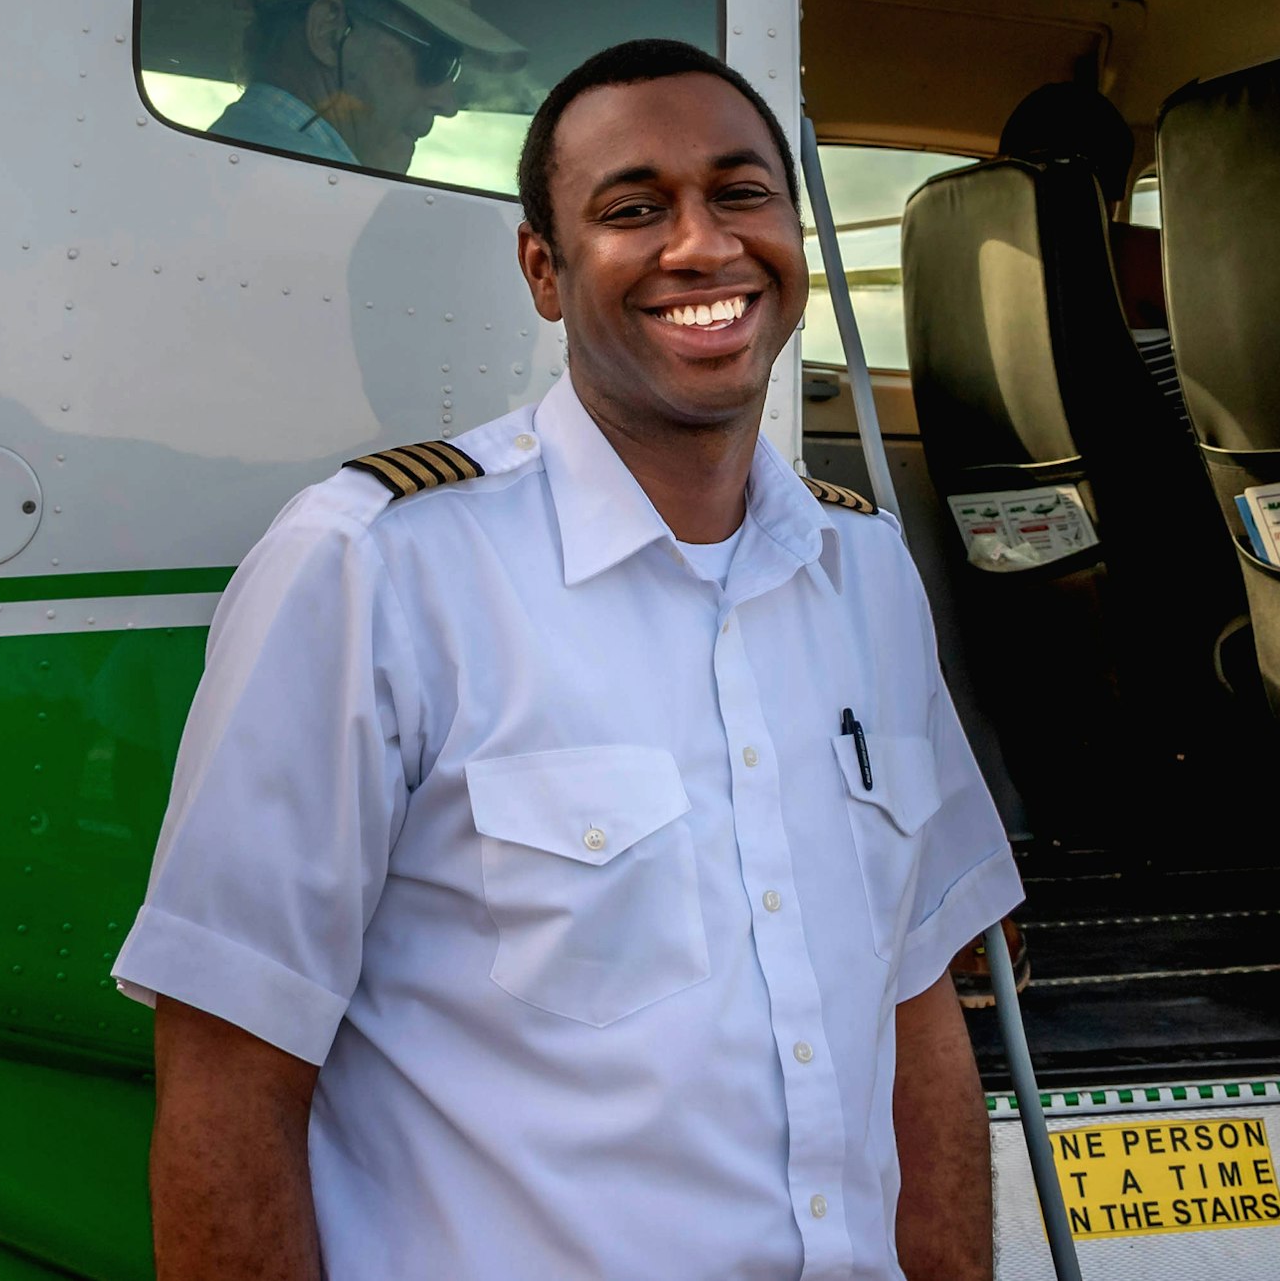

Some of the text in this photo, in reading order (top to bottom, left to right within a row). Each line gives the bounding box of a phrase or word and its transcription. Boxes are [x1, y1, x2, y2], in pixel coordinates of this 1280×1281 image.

[1050, 1121, 1265, 1160] NE PERSON
[1070, 1159, 1274, 1198] T A TIME
[1069, 1206, 1091, 1232] N
[1100, 1201, 1164, 1230] THE
